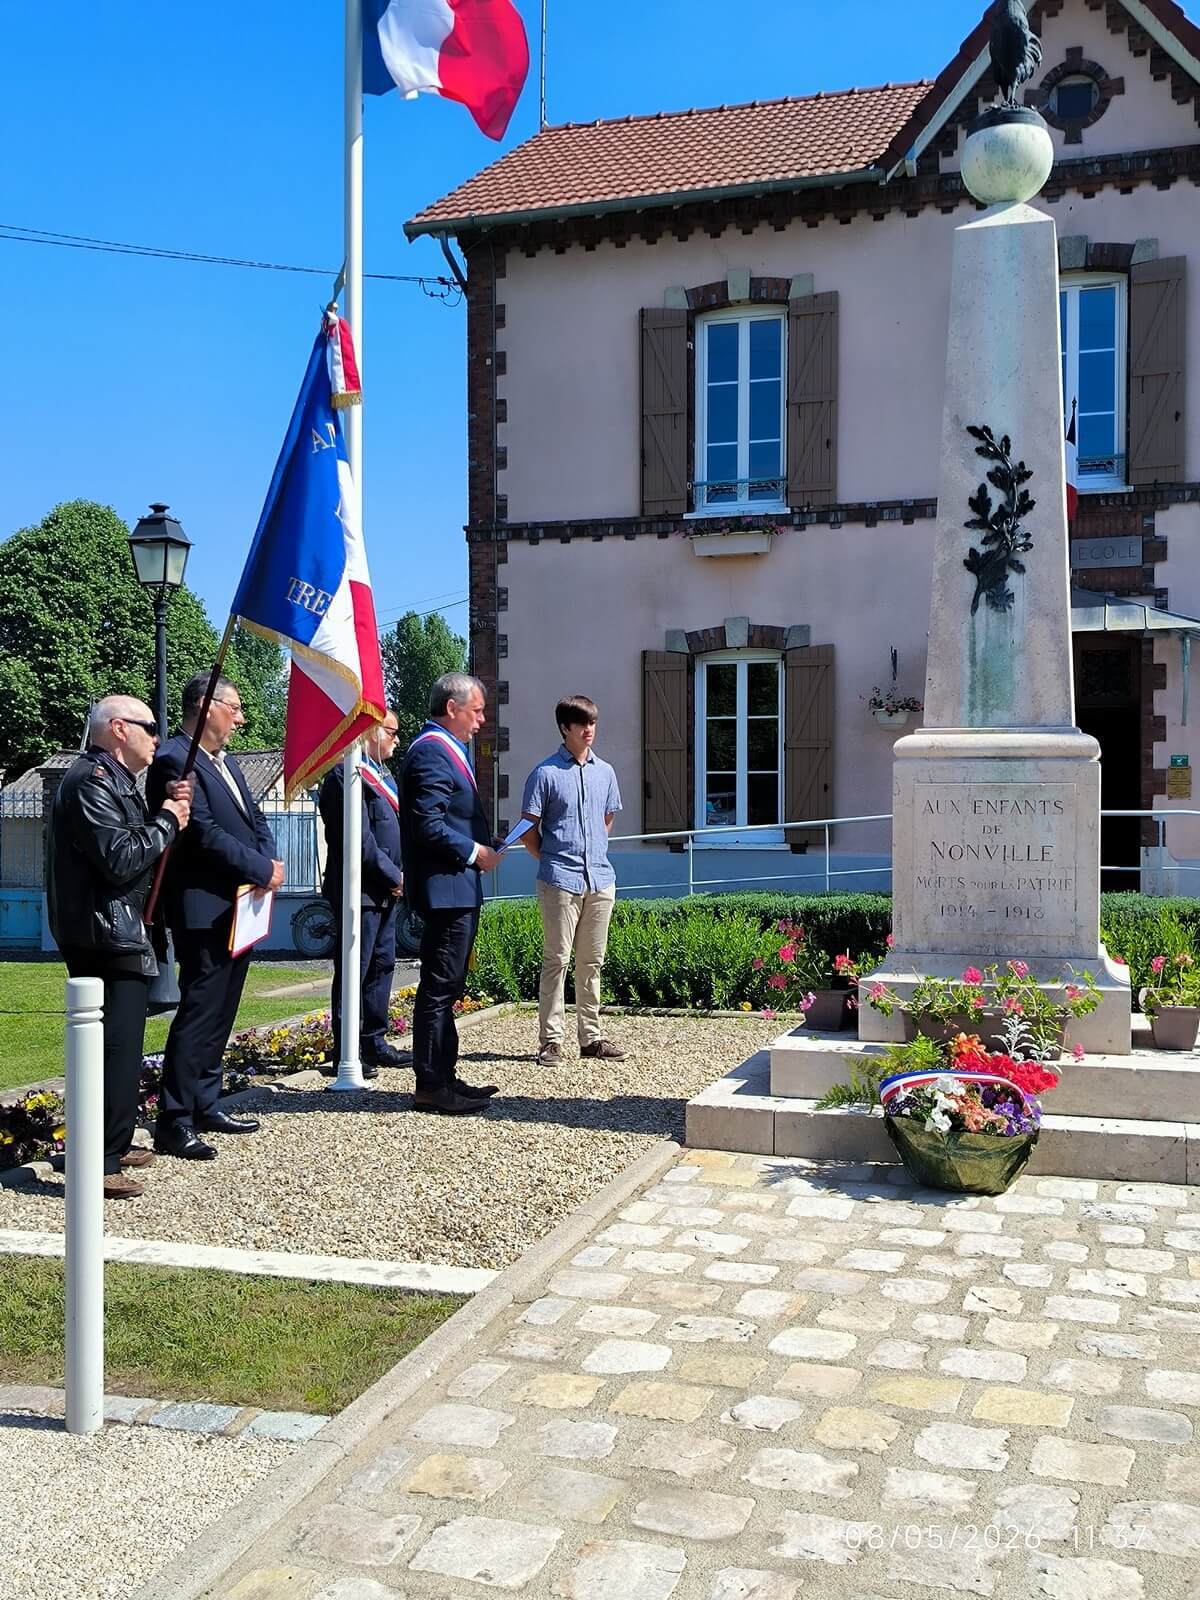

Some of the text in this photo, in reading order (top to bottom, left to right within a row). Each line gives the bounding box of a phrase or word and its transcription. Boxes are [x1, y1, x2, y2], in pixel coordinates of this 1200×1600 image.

[922, 799, 1064, 815] AUX ENFANTS
[982, 824, 1003, 835] DE
[930, 841, 1054, 862] NONVILLE
[915, 875, 1073, 892] MORTS POUR LA PATRIE
[940, 904, 977, 919] 1914
